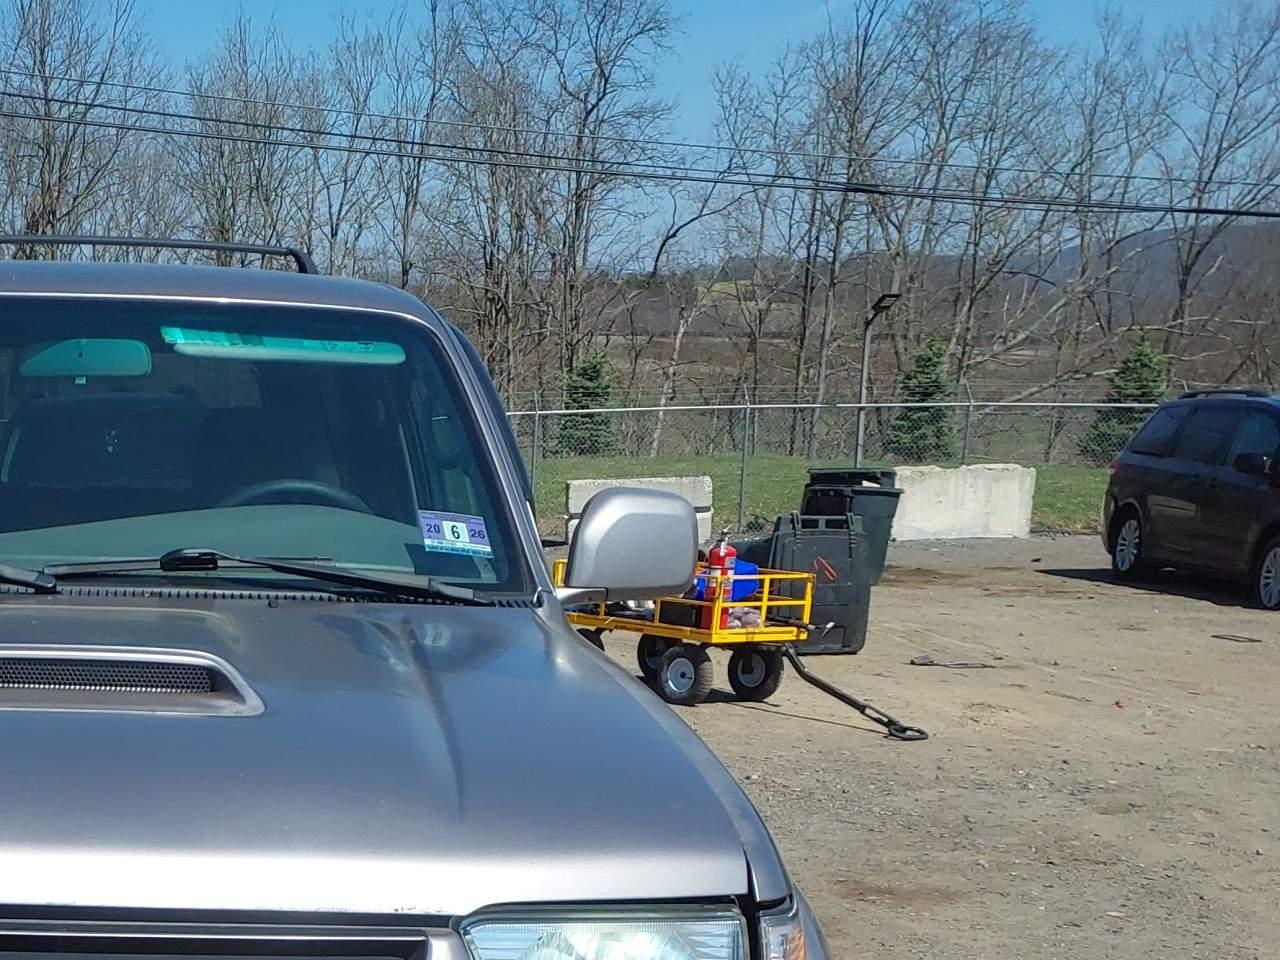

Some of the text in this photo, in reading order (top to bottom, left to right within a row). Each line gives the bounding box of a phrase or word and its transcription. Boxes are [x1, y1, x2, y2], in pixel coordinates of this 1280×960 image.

[426, 523, 486, 540] 20 6 26
